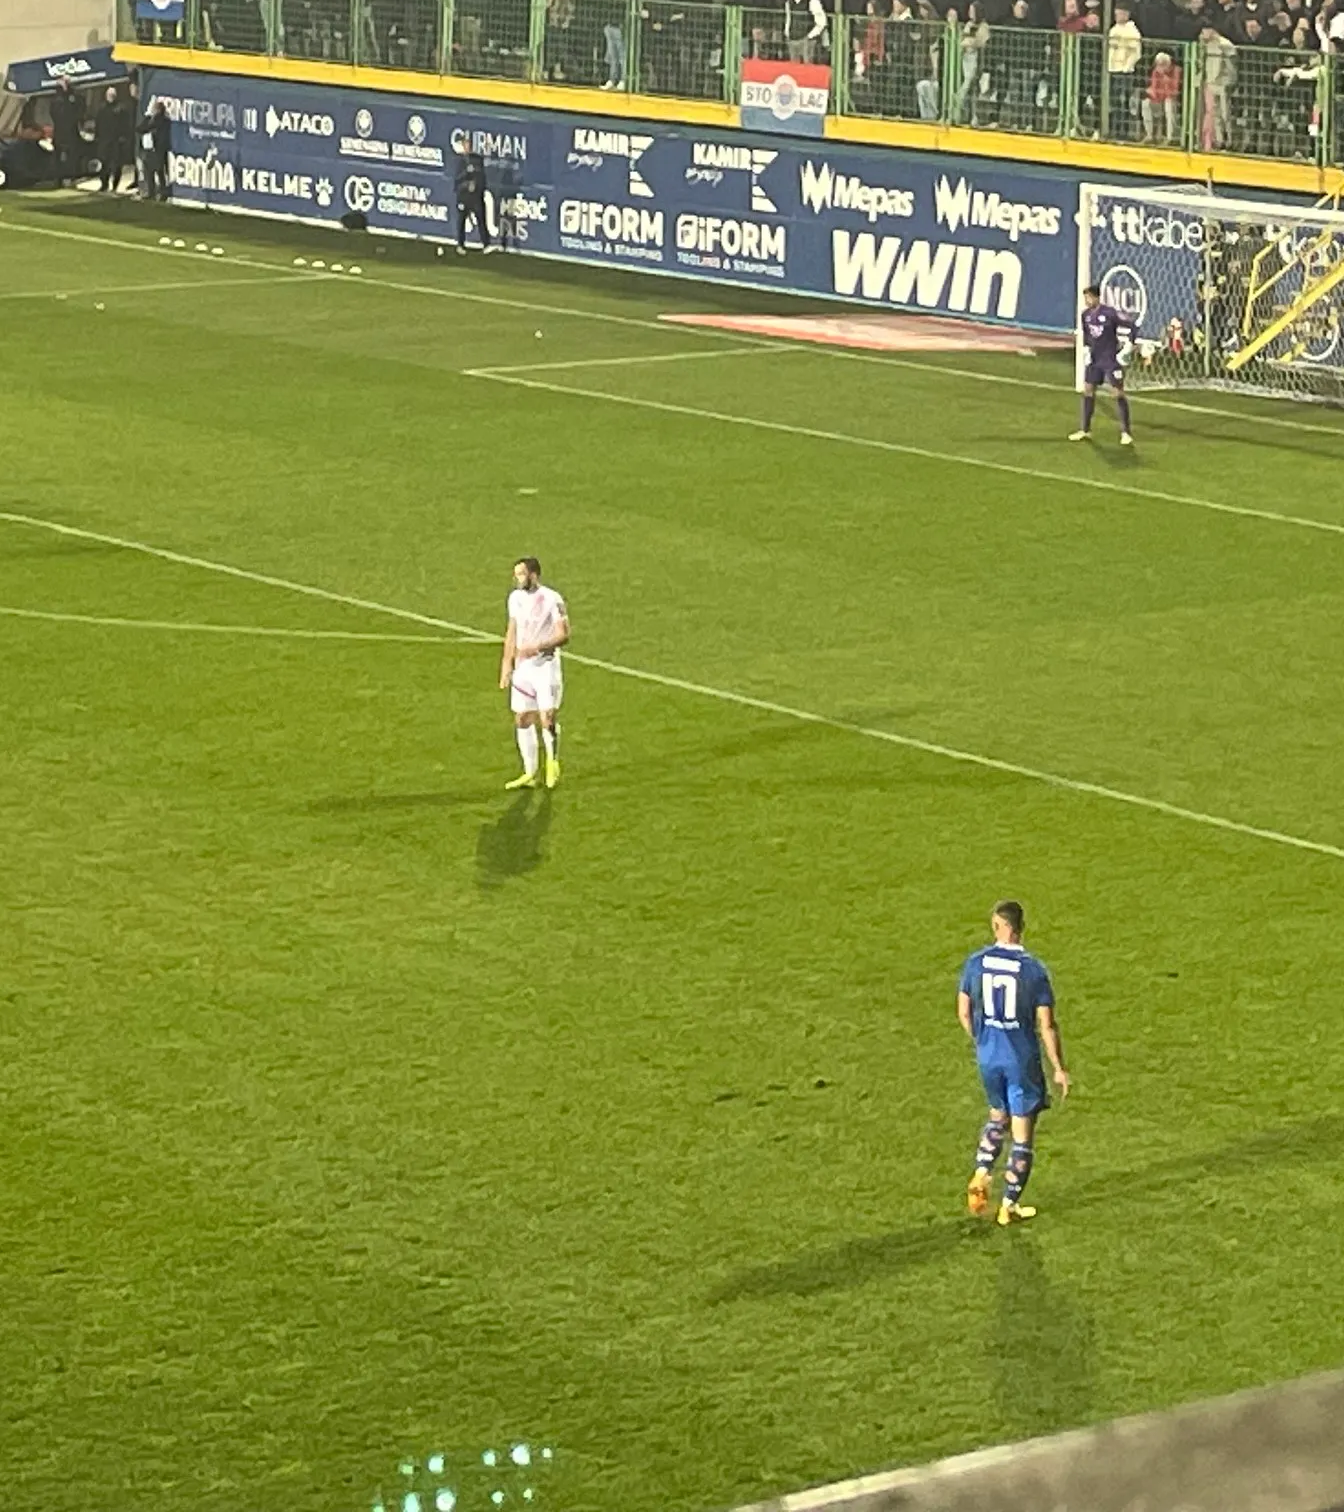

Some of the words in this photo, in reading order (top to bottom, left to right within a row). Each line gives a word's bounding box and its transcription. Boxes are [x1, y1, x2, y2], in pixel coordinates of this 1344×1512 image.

[746, 85, 772, 104] STO
[279, 110, 334, 136] ATACO
[573, 128, 629, 156] KAMIR
[693, 142, 752, 170] KAMIR
[242, 167, 313, 200] KELME
[377, 181, 428, 201] CROATIA
[377, 197, 448, 222] OSIGURANJE
[833, 174, 915, 223] Mepas
[971, 191, 1062, 241] Mepas
[1112, 204, 1206, 252] ttkabe
[982, 973, 1016, 1020] 17
